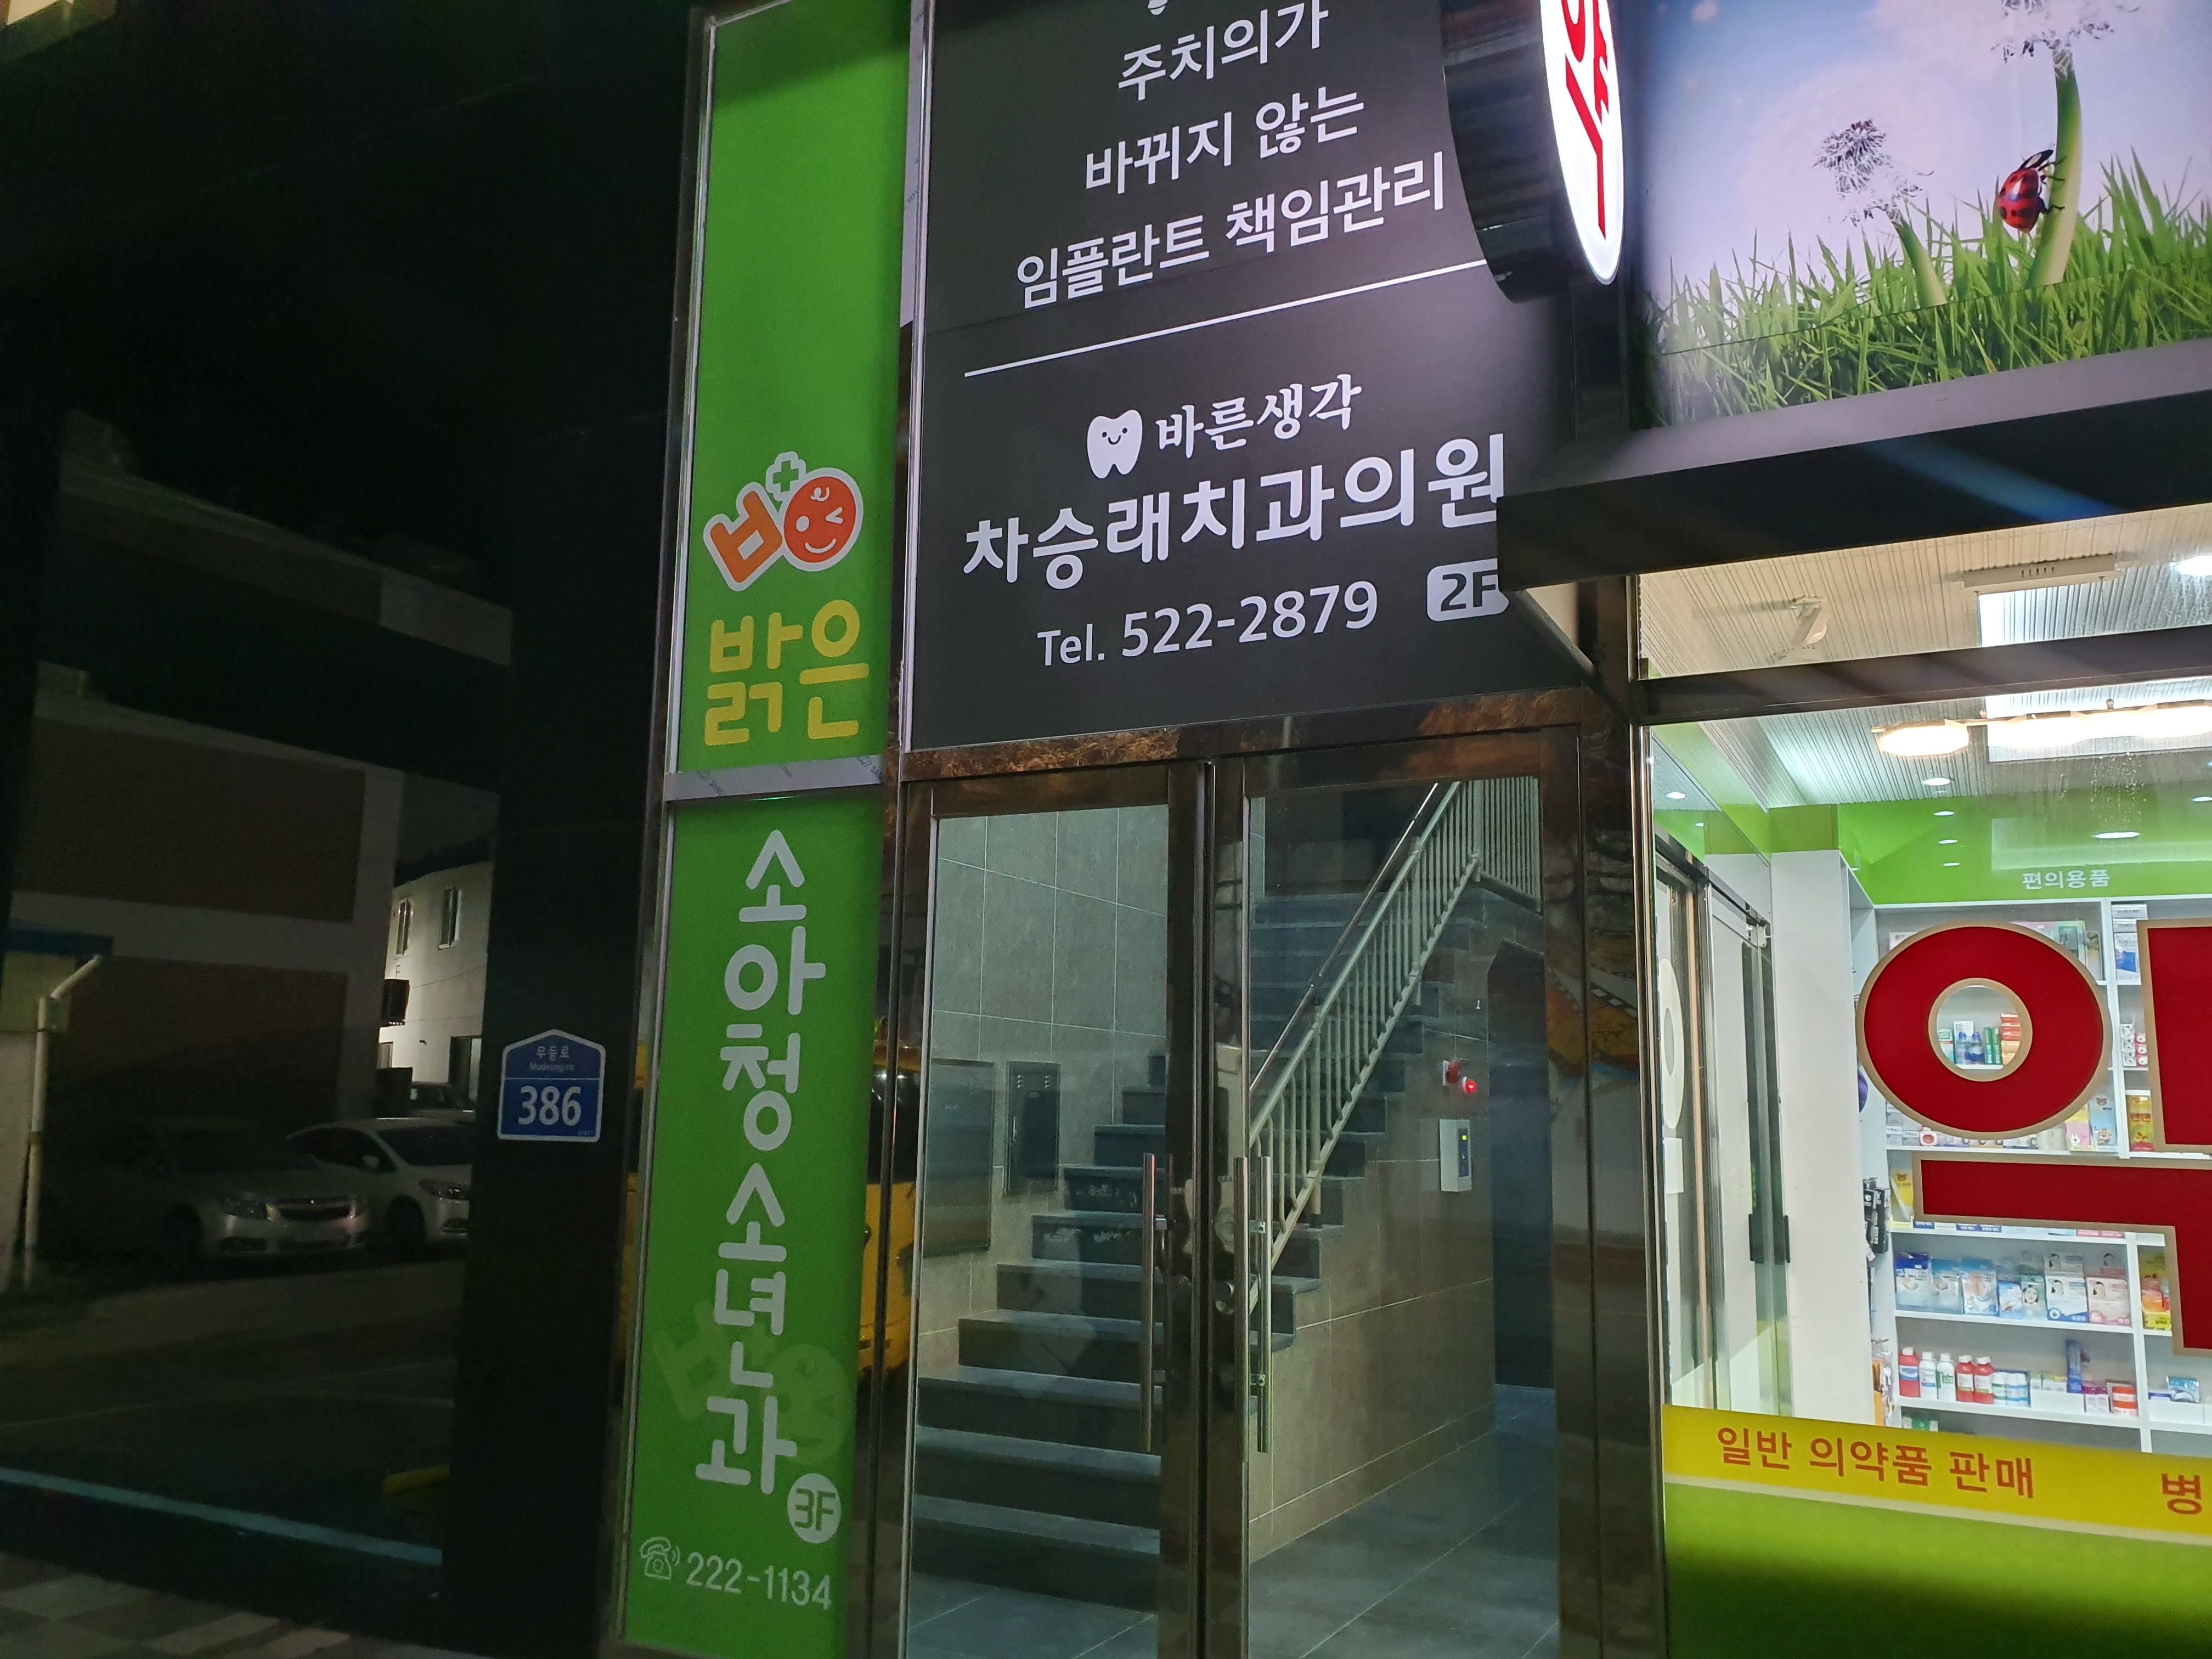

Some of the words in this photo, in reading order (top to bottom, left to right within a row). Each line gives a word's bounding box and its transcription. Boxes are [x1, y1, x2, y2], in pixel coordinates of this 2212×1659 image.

[1118, 2, 1328, 101] 주치의가
[1086, 111, 1232, 194] 바뀌지
[1256, 86, 1364, 159] 않는
[1017, 215, 1210, 309] 임플란트
[1226, 151, 1444, 253] 책임관리
[1155, 374, 1362, 459] 바른생각
[963, 433, 1504, 590] 차승래치과의원
[1037, 629, 1105, 666] Tel.
[1122, 580, 1378, 657] 522-2879
[1440, 569, 1498, 612] 2F
[704, 600, 870, 746] 밝은
[2022, 868, 2111, 890] 편의용품
[535, 1045, 570, 1062] 무등로
[518, 1086, 582, 1126] 386
[695, 830, 826, 1494] 소아청소년과
[1717, 1427, 1792, 1470] 일반
[1809, 1437, 1933, 1487] 의약품
[1949, 1451, 2035, 1499] 판매
[2162, 1472, 2203, 1515] 병
[793, 1488, 836, 1531] 3F
[686, 1551, 832, 1611] 222-1134
